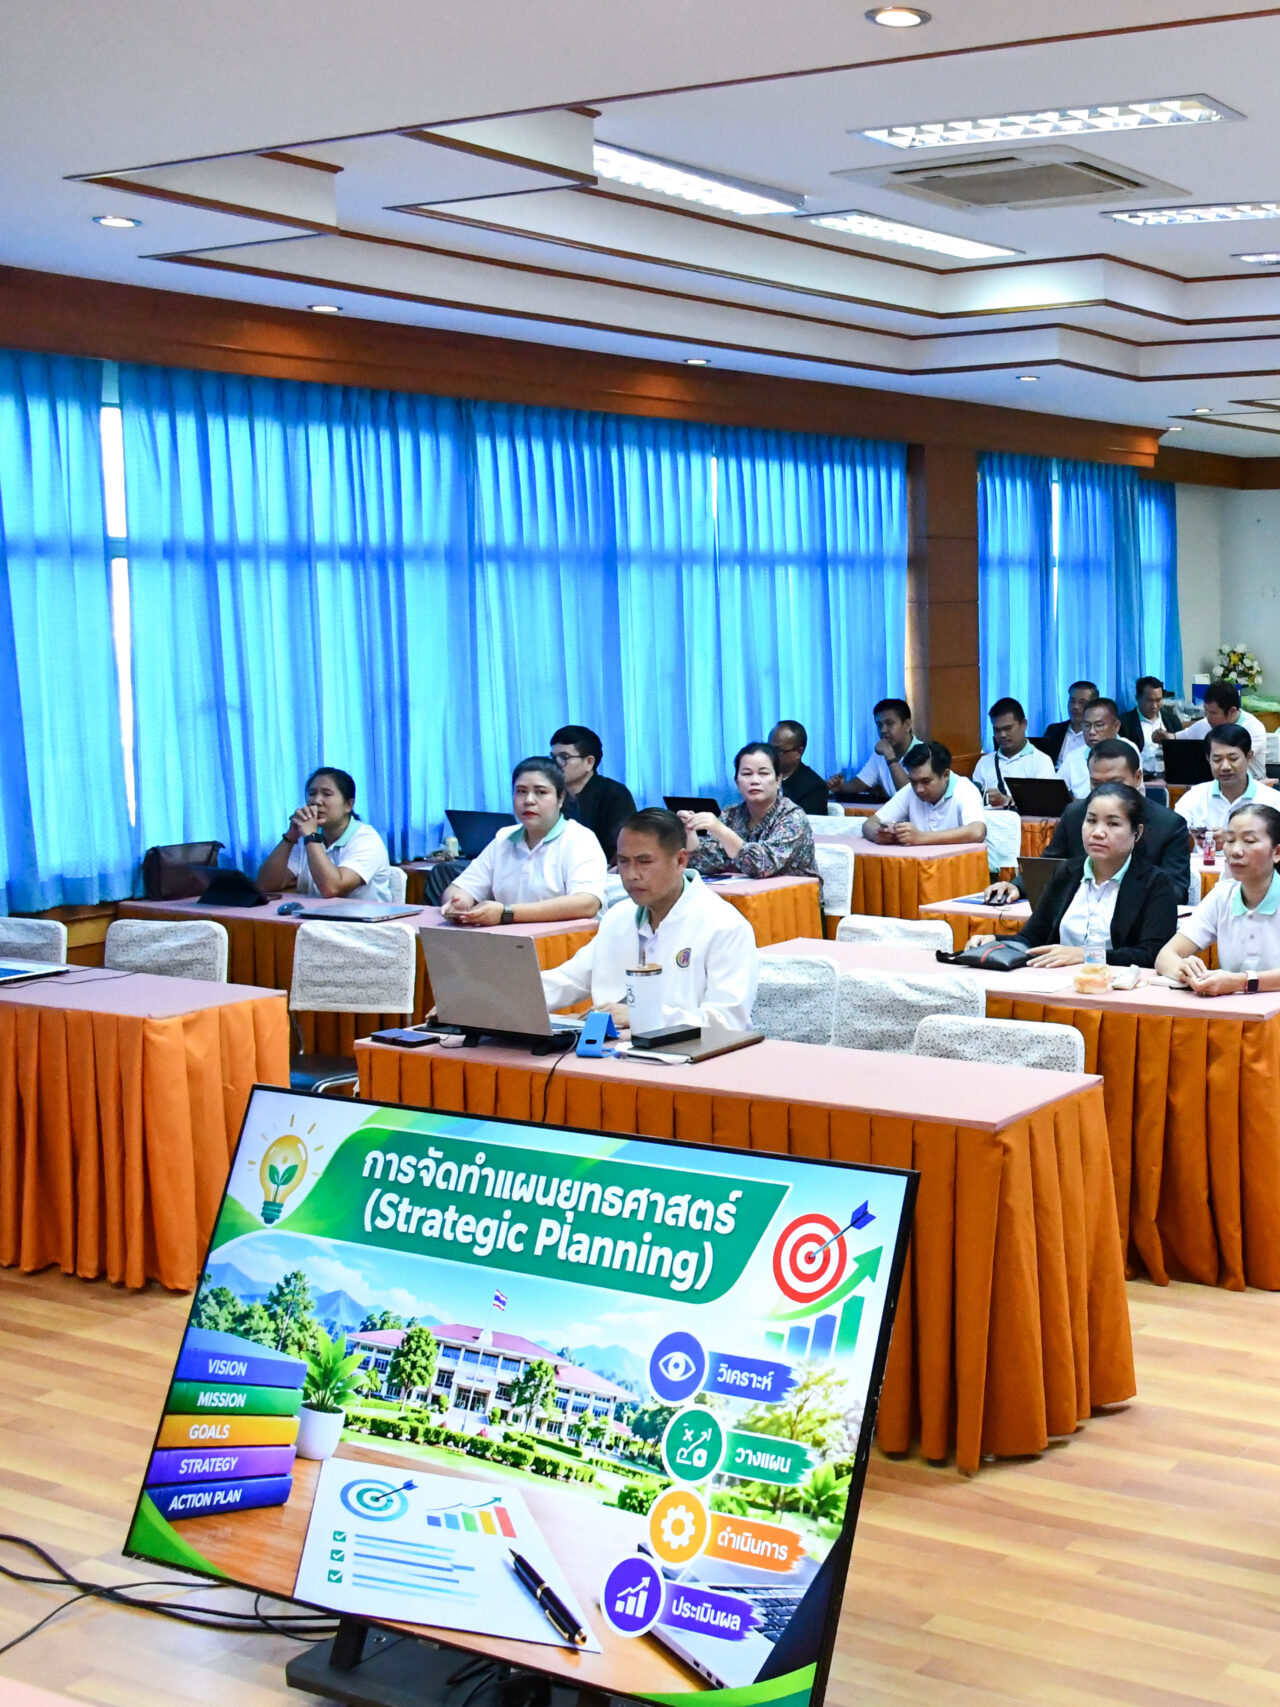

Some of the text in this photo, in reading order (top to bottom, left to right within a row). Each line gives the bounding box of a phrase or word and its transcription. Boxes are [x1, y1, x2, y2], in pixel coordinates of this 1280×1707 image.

[362, 1146, 743, 1235] การจัดทำแผนยุทธศาสตร์
[363, 1187, 714, 1292] (Strategic Planning)
[208, 1359, 248, 1377] VISION
[717, 1363, 775, 1391] วิเคราะห์
[197, 1391, 247, 1408] MISSION
[189, 1424, 230, 1439] GOALS
[179, 1456, 239, 1474] STRATEGY
[734, 1447, 792, 1473] วางแผน
[168, 1488, 242, 1511] ACTION PLAN
[717, 1525, 788, 1561] ดำเนินการ
[671, 1596, 741, 1631] ประเมินผล
